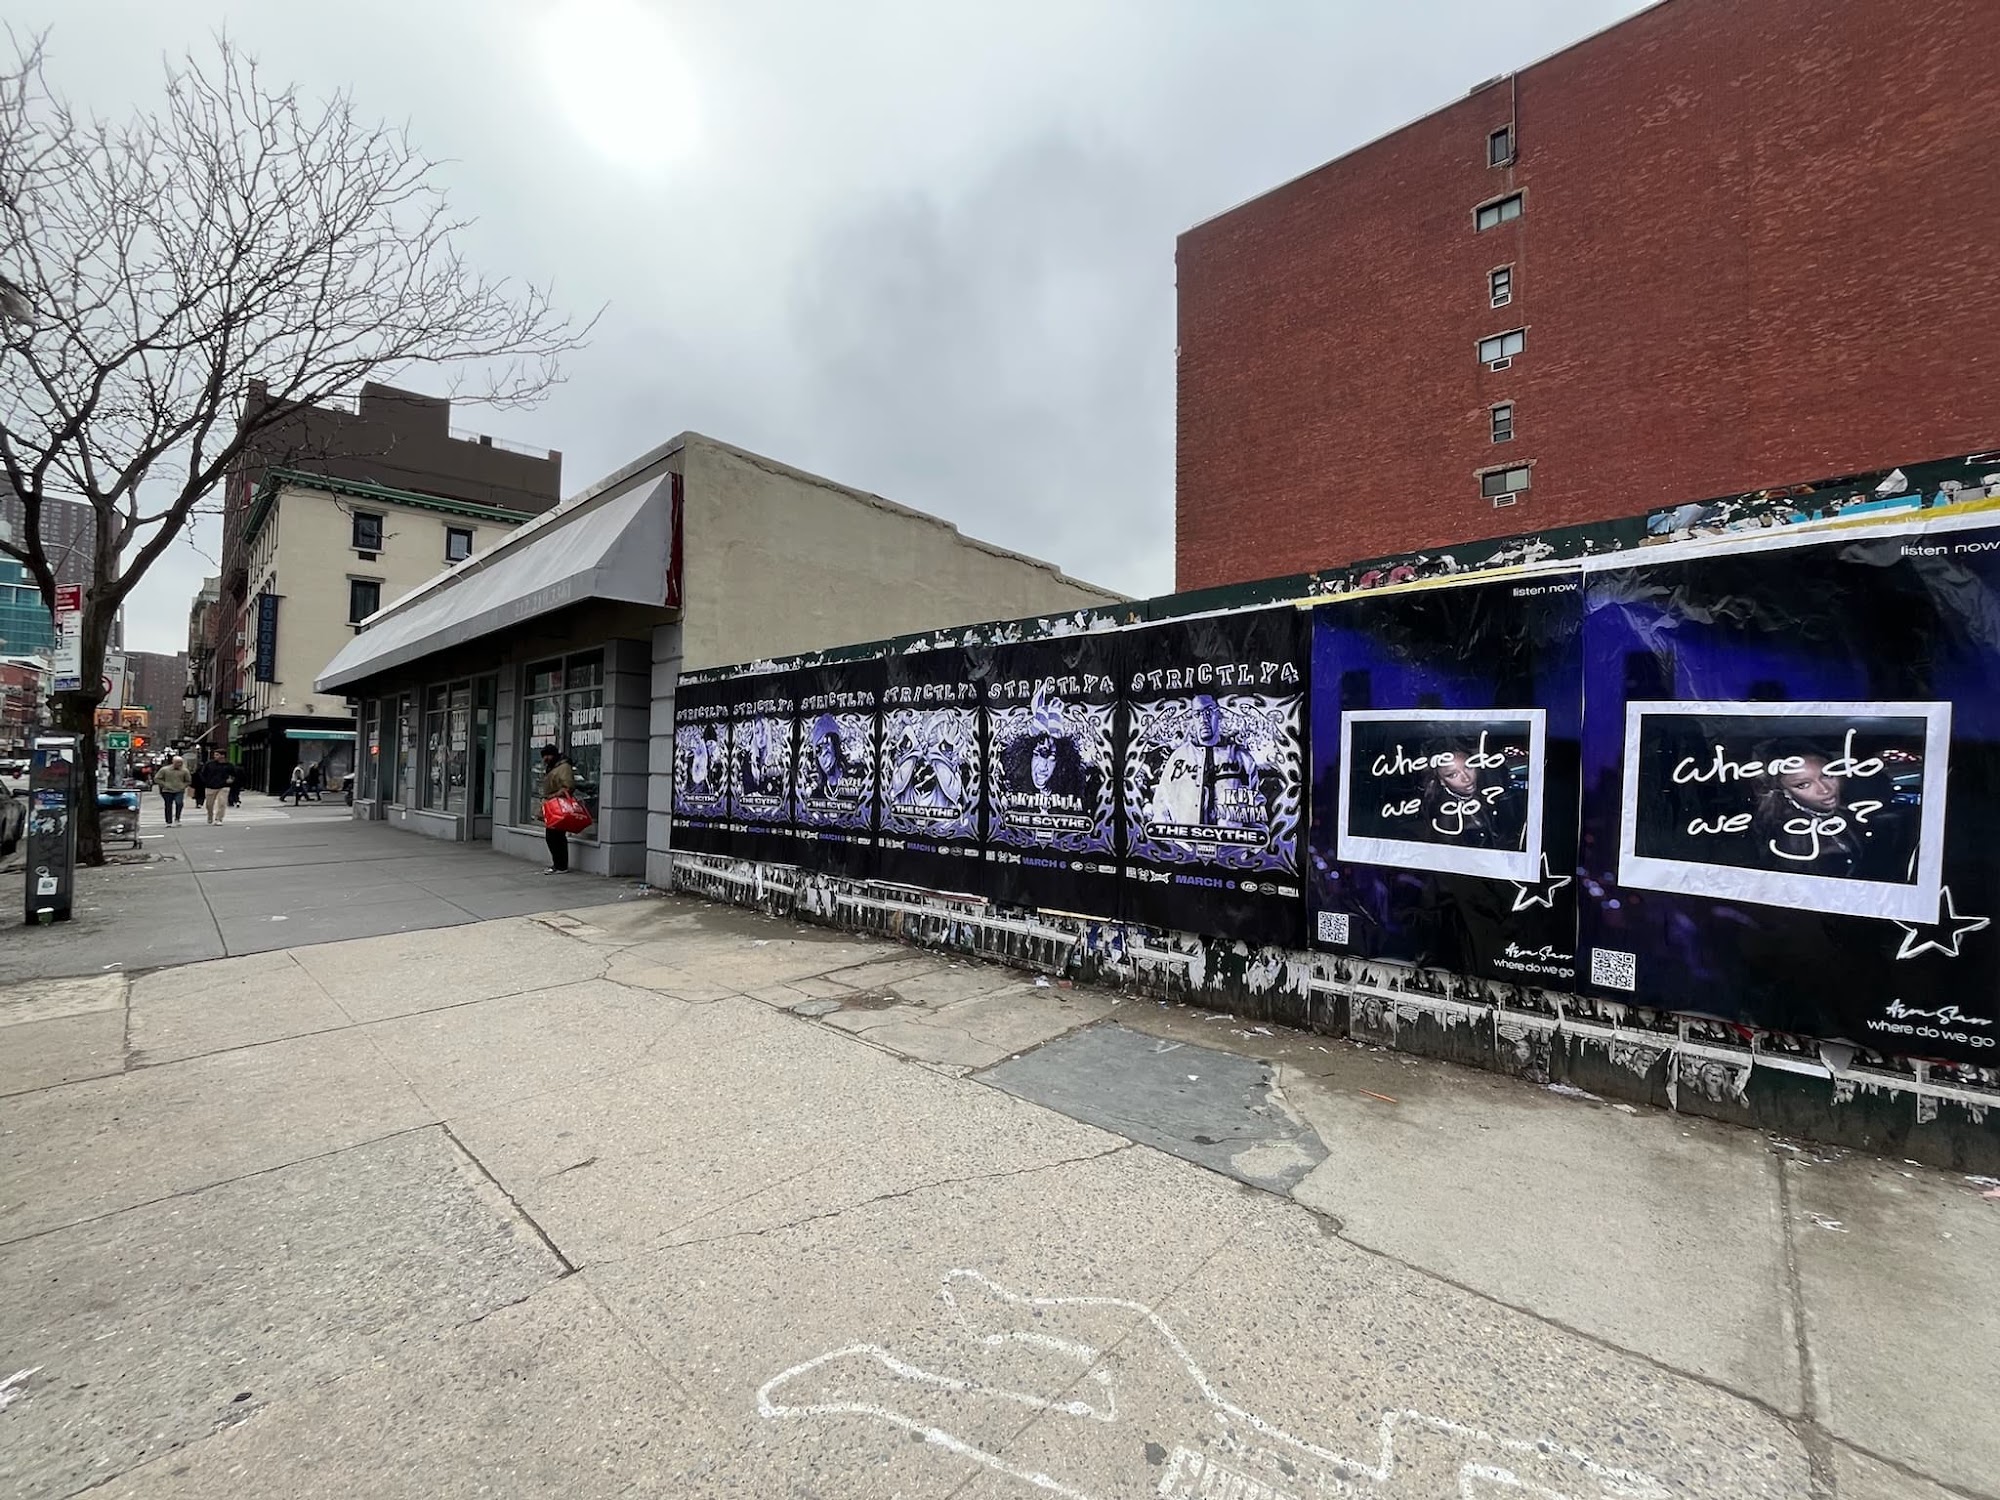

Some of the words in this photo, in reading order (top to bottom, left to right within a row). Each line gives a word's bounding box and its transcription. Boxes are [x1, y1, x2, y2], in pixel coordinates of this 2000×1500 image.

[1901, 545, 1948, 556] listen
[1954, 541, 2000, 553] now
[1513, 586, 1546, 597] listen
[1549, 583, 1577, 593] now
[1372, 744, 1456, 776] where
[1465, 730, 1506, 769] do
[1672, 745, 1806, 784] where
[1822, 728, 1885, 778] do
[896, 806, 914, 815] THE
[1381, 799, 1422, 818] we
[1432, 786, 1505, 836] go?
[1010, 814, 1030, 824] THE
[1032, 816, 1085, 829] SCYTHE
[1156, 825, 1188, 837] THE
[1190, 827, 1258, 843] SCYTHE
[1687, 813, 1752, 836] we
[1769, 801, 1884, 861] go?
[1059, 862, 1067, 870] 6
[1175, 874, 1223, 888] MARCH
[1226, 880, 1236, 889] 6
[1493, 958, 1525, 971] where
[1525, 962, 1541, 973] do
[1542, 966, 1558, 975] we
[1558, 967, 1575, 978] go
[1867, 1020, 1914, 1035] where
[1916, 1026, 1940, 1038] do
[1942, 1030, 1968, 1043] we
[1970, 1036, 1996, 1048] go
